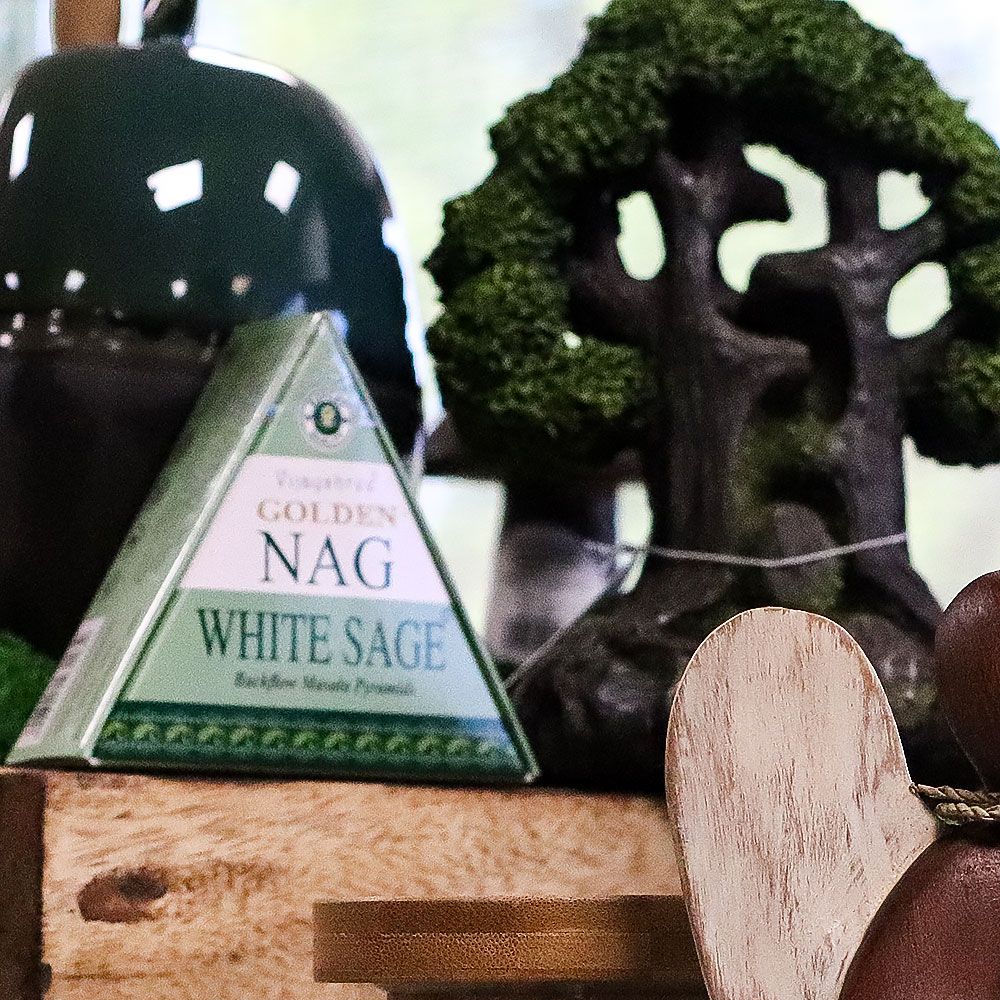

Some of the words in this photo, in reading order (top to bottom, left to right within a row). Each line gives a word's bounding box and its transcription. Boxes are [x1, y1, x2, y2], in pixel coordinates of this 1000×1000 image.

[256, 499, 397, 526] GOLDEN
[260, 529, 394, 591] NAG
[199, 608, 331, 666] WHITE
[344, 612, 448, 671] SAGE
